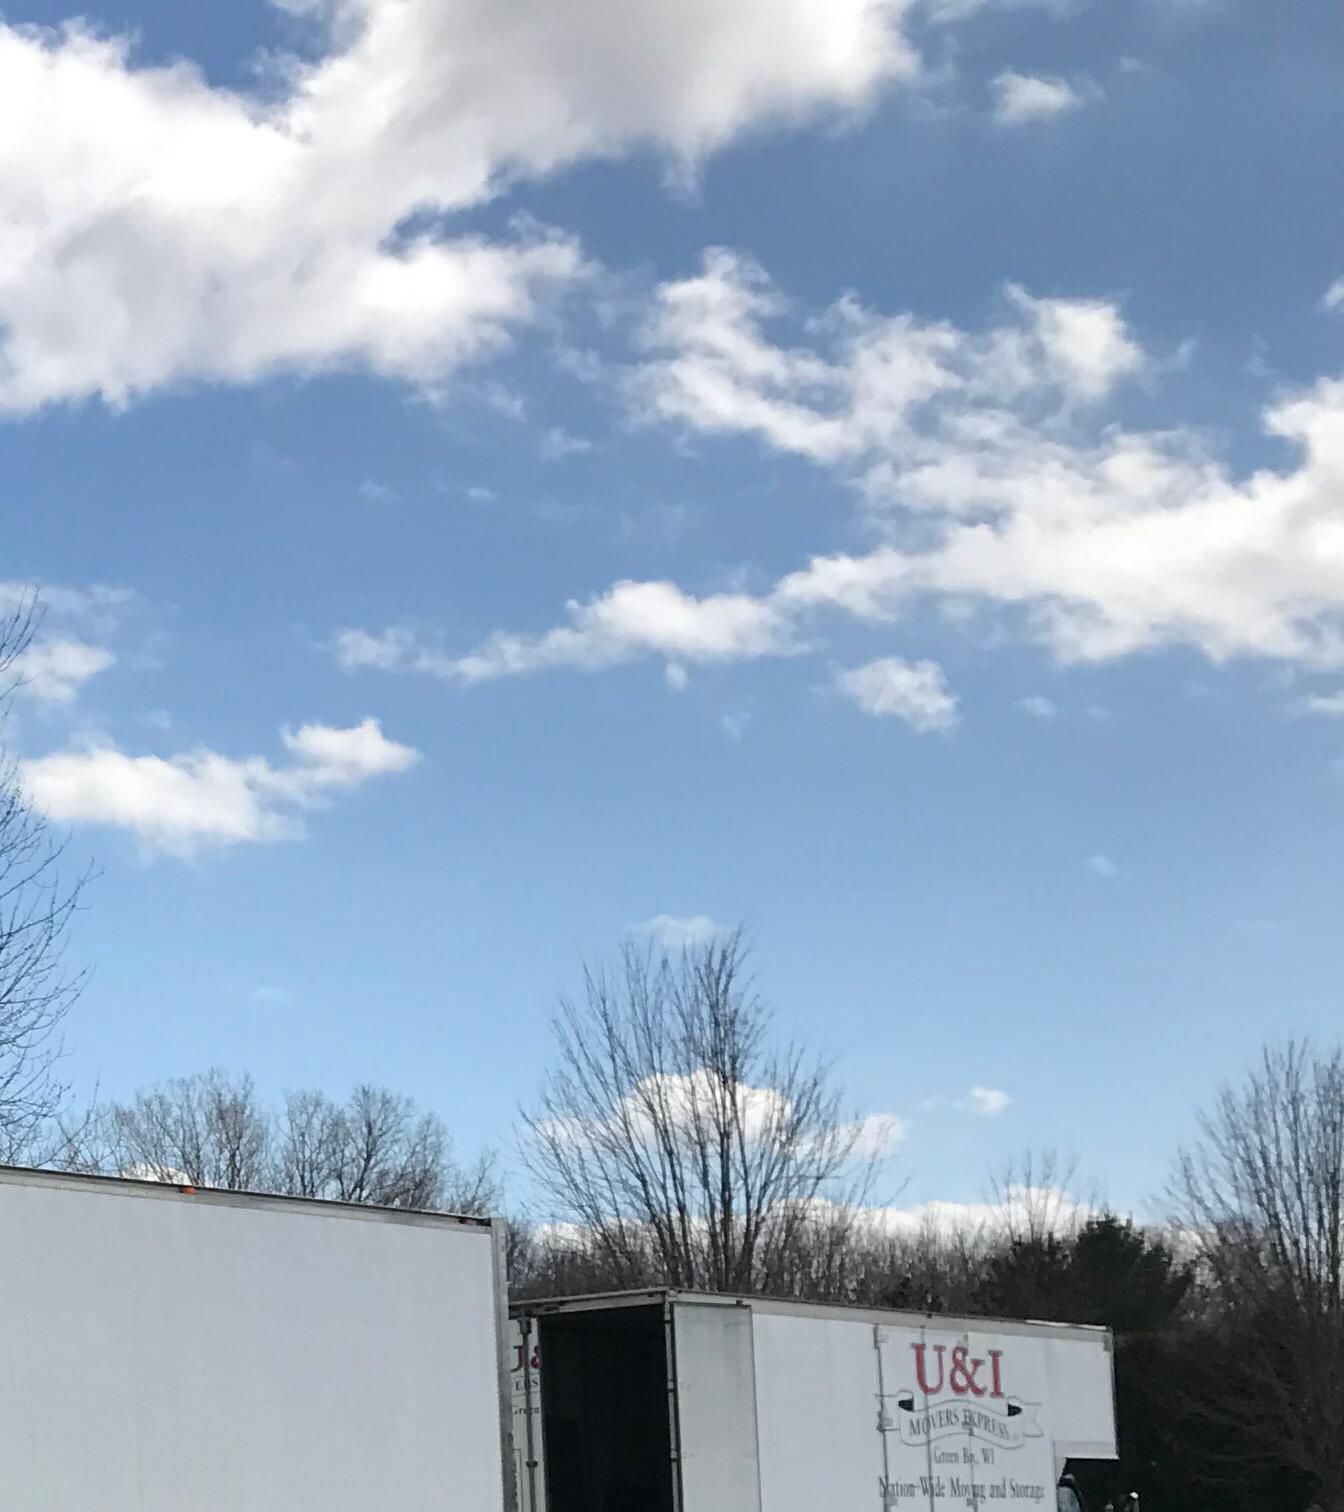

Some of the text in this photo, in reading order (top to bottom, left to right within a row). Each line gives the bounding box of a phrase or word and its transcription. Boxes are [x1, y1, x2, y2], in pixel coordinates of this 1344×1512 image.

[910, 1342, 1006, 1399] U&I
[909, 1409, 960, 1436] MOVERS
[990, 1477, 1007, 1499] and
